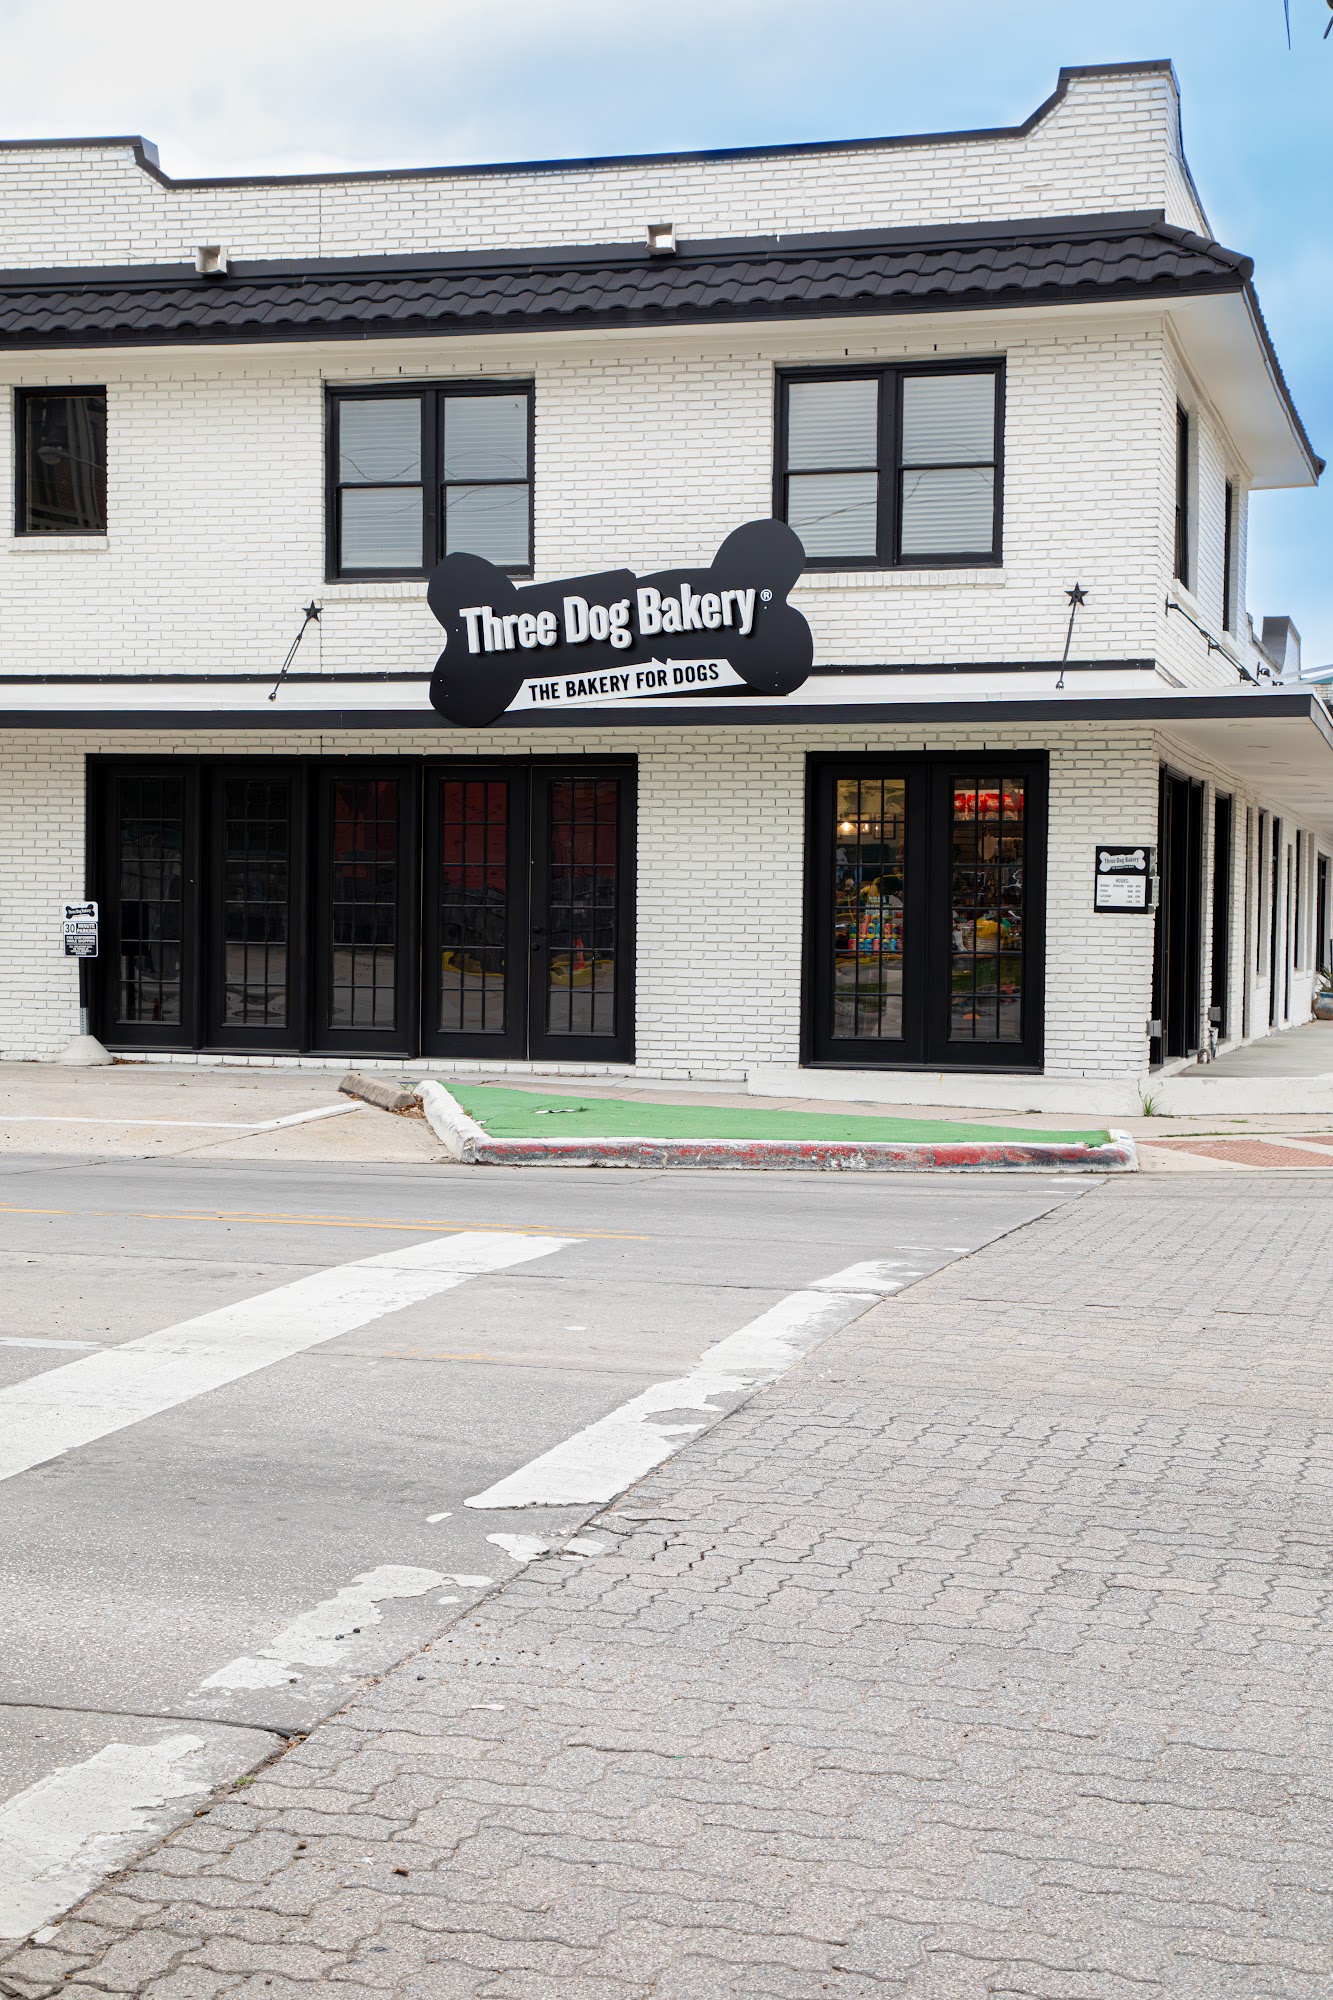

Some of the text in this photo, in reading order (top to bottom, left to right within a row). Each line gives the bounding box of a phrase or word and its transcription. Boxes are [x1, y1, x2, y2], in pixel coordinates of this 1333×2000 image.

[459, 606, 557, 654] Three
[563, 595, 632, 649] Dog
[528, 663, 719, 701] THE BAKERY FOR DOGS
[65, 923, 75, 933] 30
